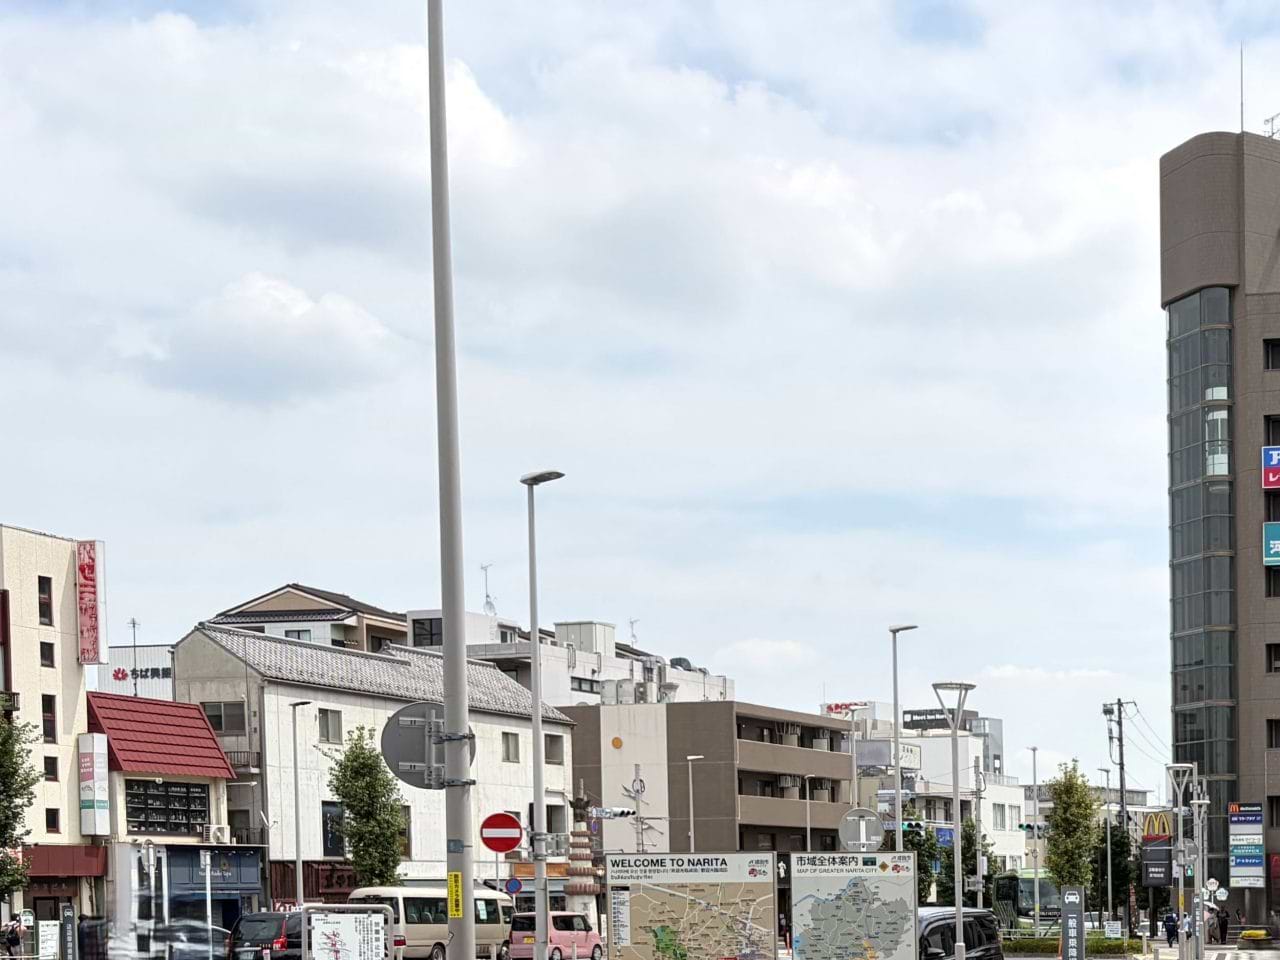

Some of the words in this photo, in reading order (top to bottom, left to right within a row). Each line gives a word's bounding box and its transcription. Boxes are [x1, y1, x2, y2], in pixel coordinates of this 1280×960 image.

[611, 859, 667, 868] WELCOME
[670, 859, 684, 867] TO
[691, 858, 728, 867] NARITA
[796, 856, 859, 867] 市域全体案内
